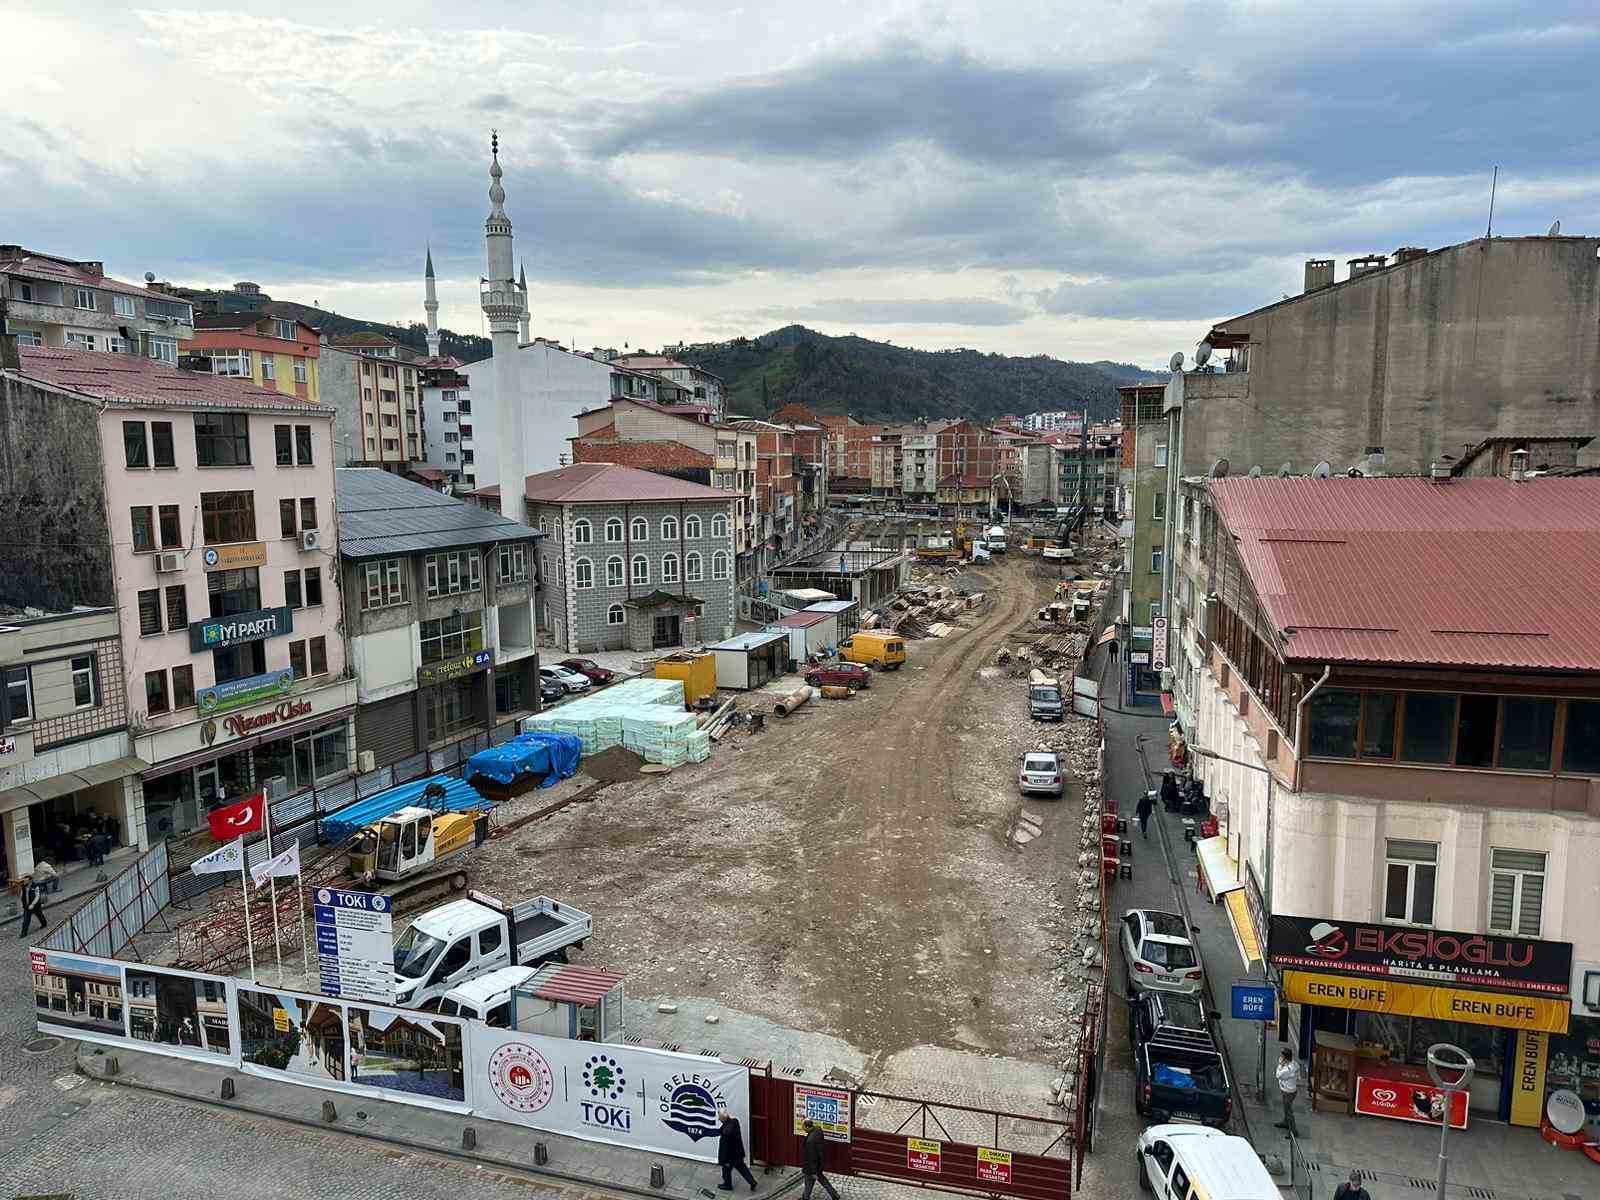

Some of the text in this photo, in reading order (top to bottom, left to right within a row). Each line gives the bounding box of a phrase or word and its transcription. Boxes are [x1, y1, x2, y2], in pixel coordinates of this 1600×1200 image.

[223, 714, 278, 737] Nizam
[1354, 927, 1534, 968] EKŞİOĞLU
[1304, 959, 1343, 969] KADASTRO
[1439, 964, 1500, 977] PLANLAMA
[1308, 983, 1387, 1002] EREN BÜFE
[1452, 999, 1535, 1019] EREN BÜFE
[1521, 1059, 1537, 1092] EREN
[663, 1073, 728, 1109] BELEDİYE
[659, 1096, 670, 1113] OF
